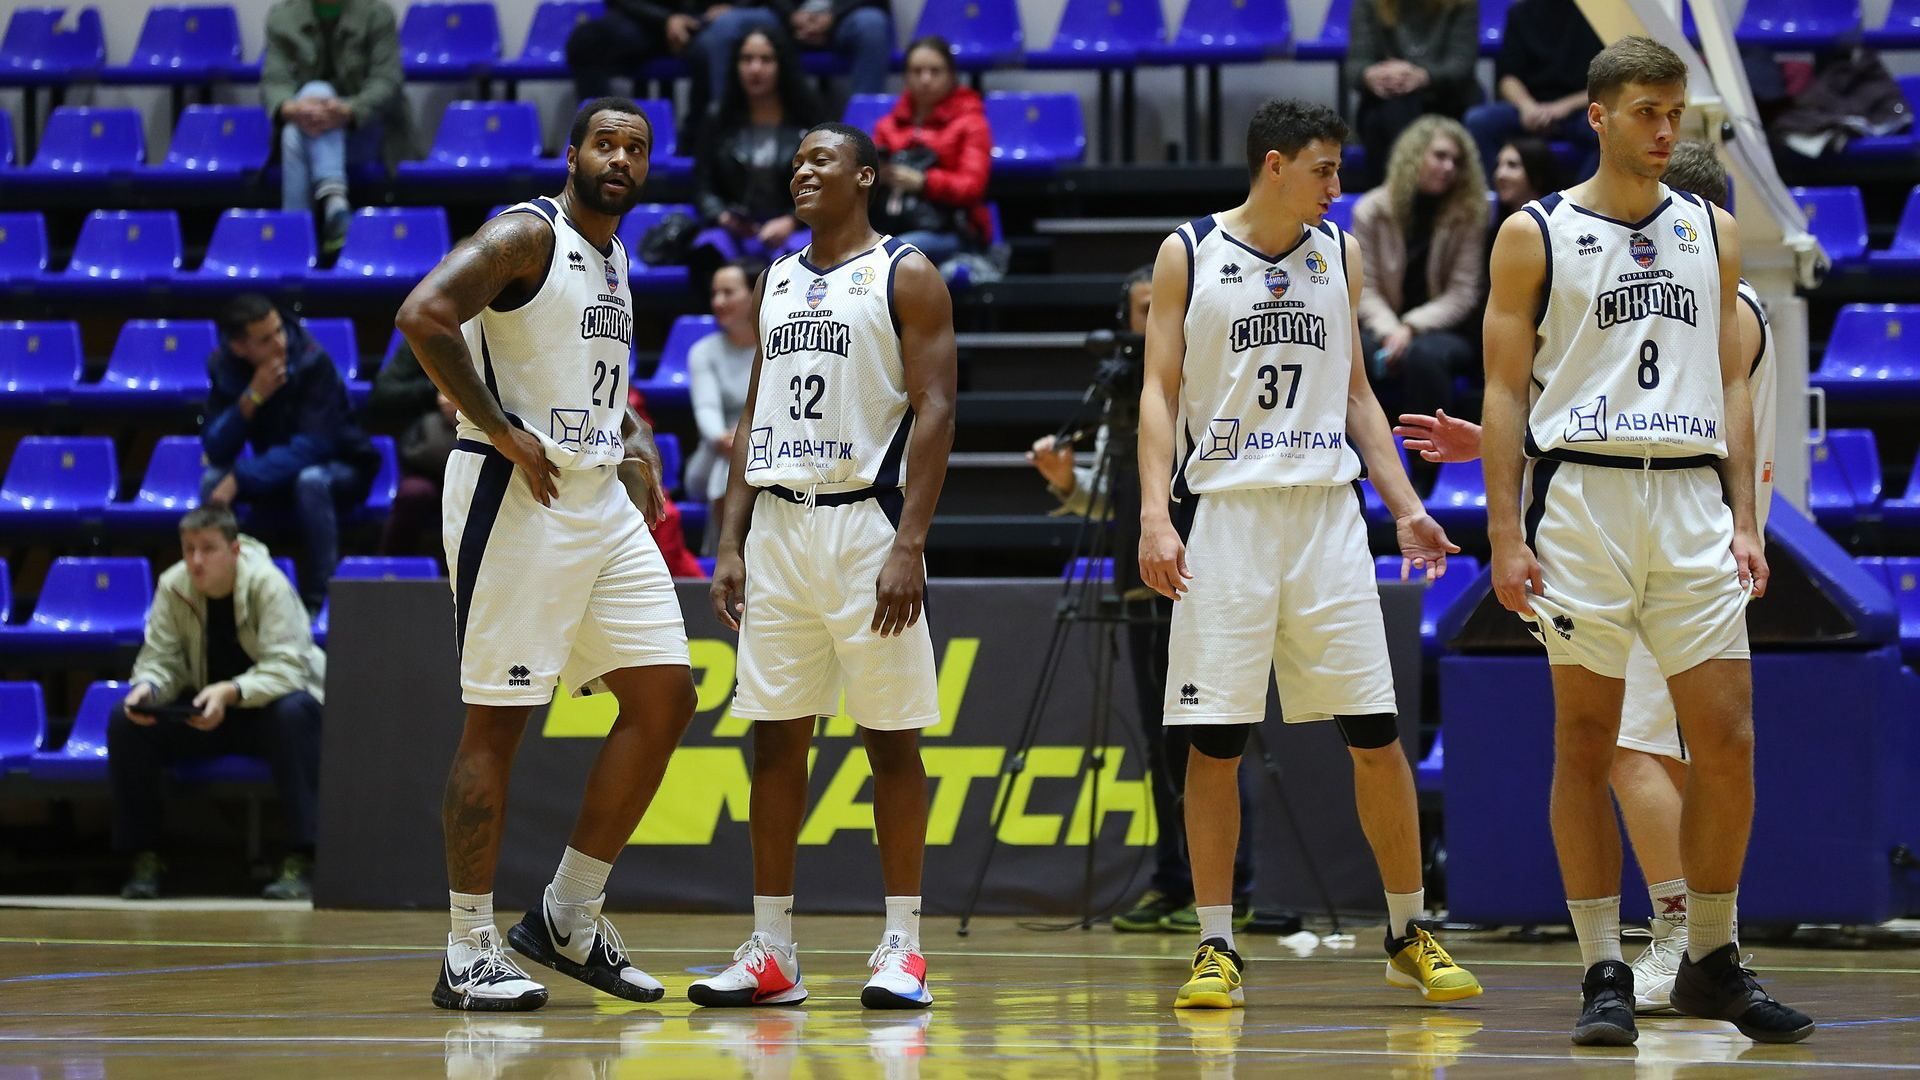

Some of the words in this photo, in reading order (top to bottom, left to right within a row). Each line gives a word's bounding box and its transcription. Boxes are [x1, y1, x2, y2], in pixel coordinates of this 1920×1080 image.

[1678, 243, 1700, 254] ФБУ
[848, 287, 870, 296] ФБУ
[1310, 275, 1330, 285] ФБУ
[1595, 282, 1698, 329] СОКОЛИ
[766, 320, 851, 360] СОКОЛИ
[1230, 312, 1327, 353] СОКОЛИ
[592, 360, 621, 409] 21
[1638, 340, 1660, 389] 8
[789, 374, 825, 420] 32
[1257, 364, 1303, 410] 37
[1244, 430, 1342, 449] АВАНТАЖ
[1615, 413, 1717, 439] АВАНТАЖ
[778, 439, 853, 460] АВАНТЖ
